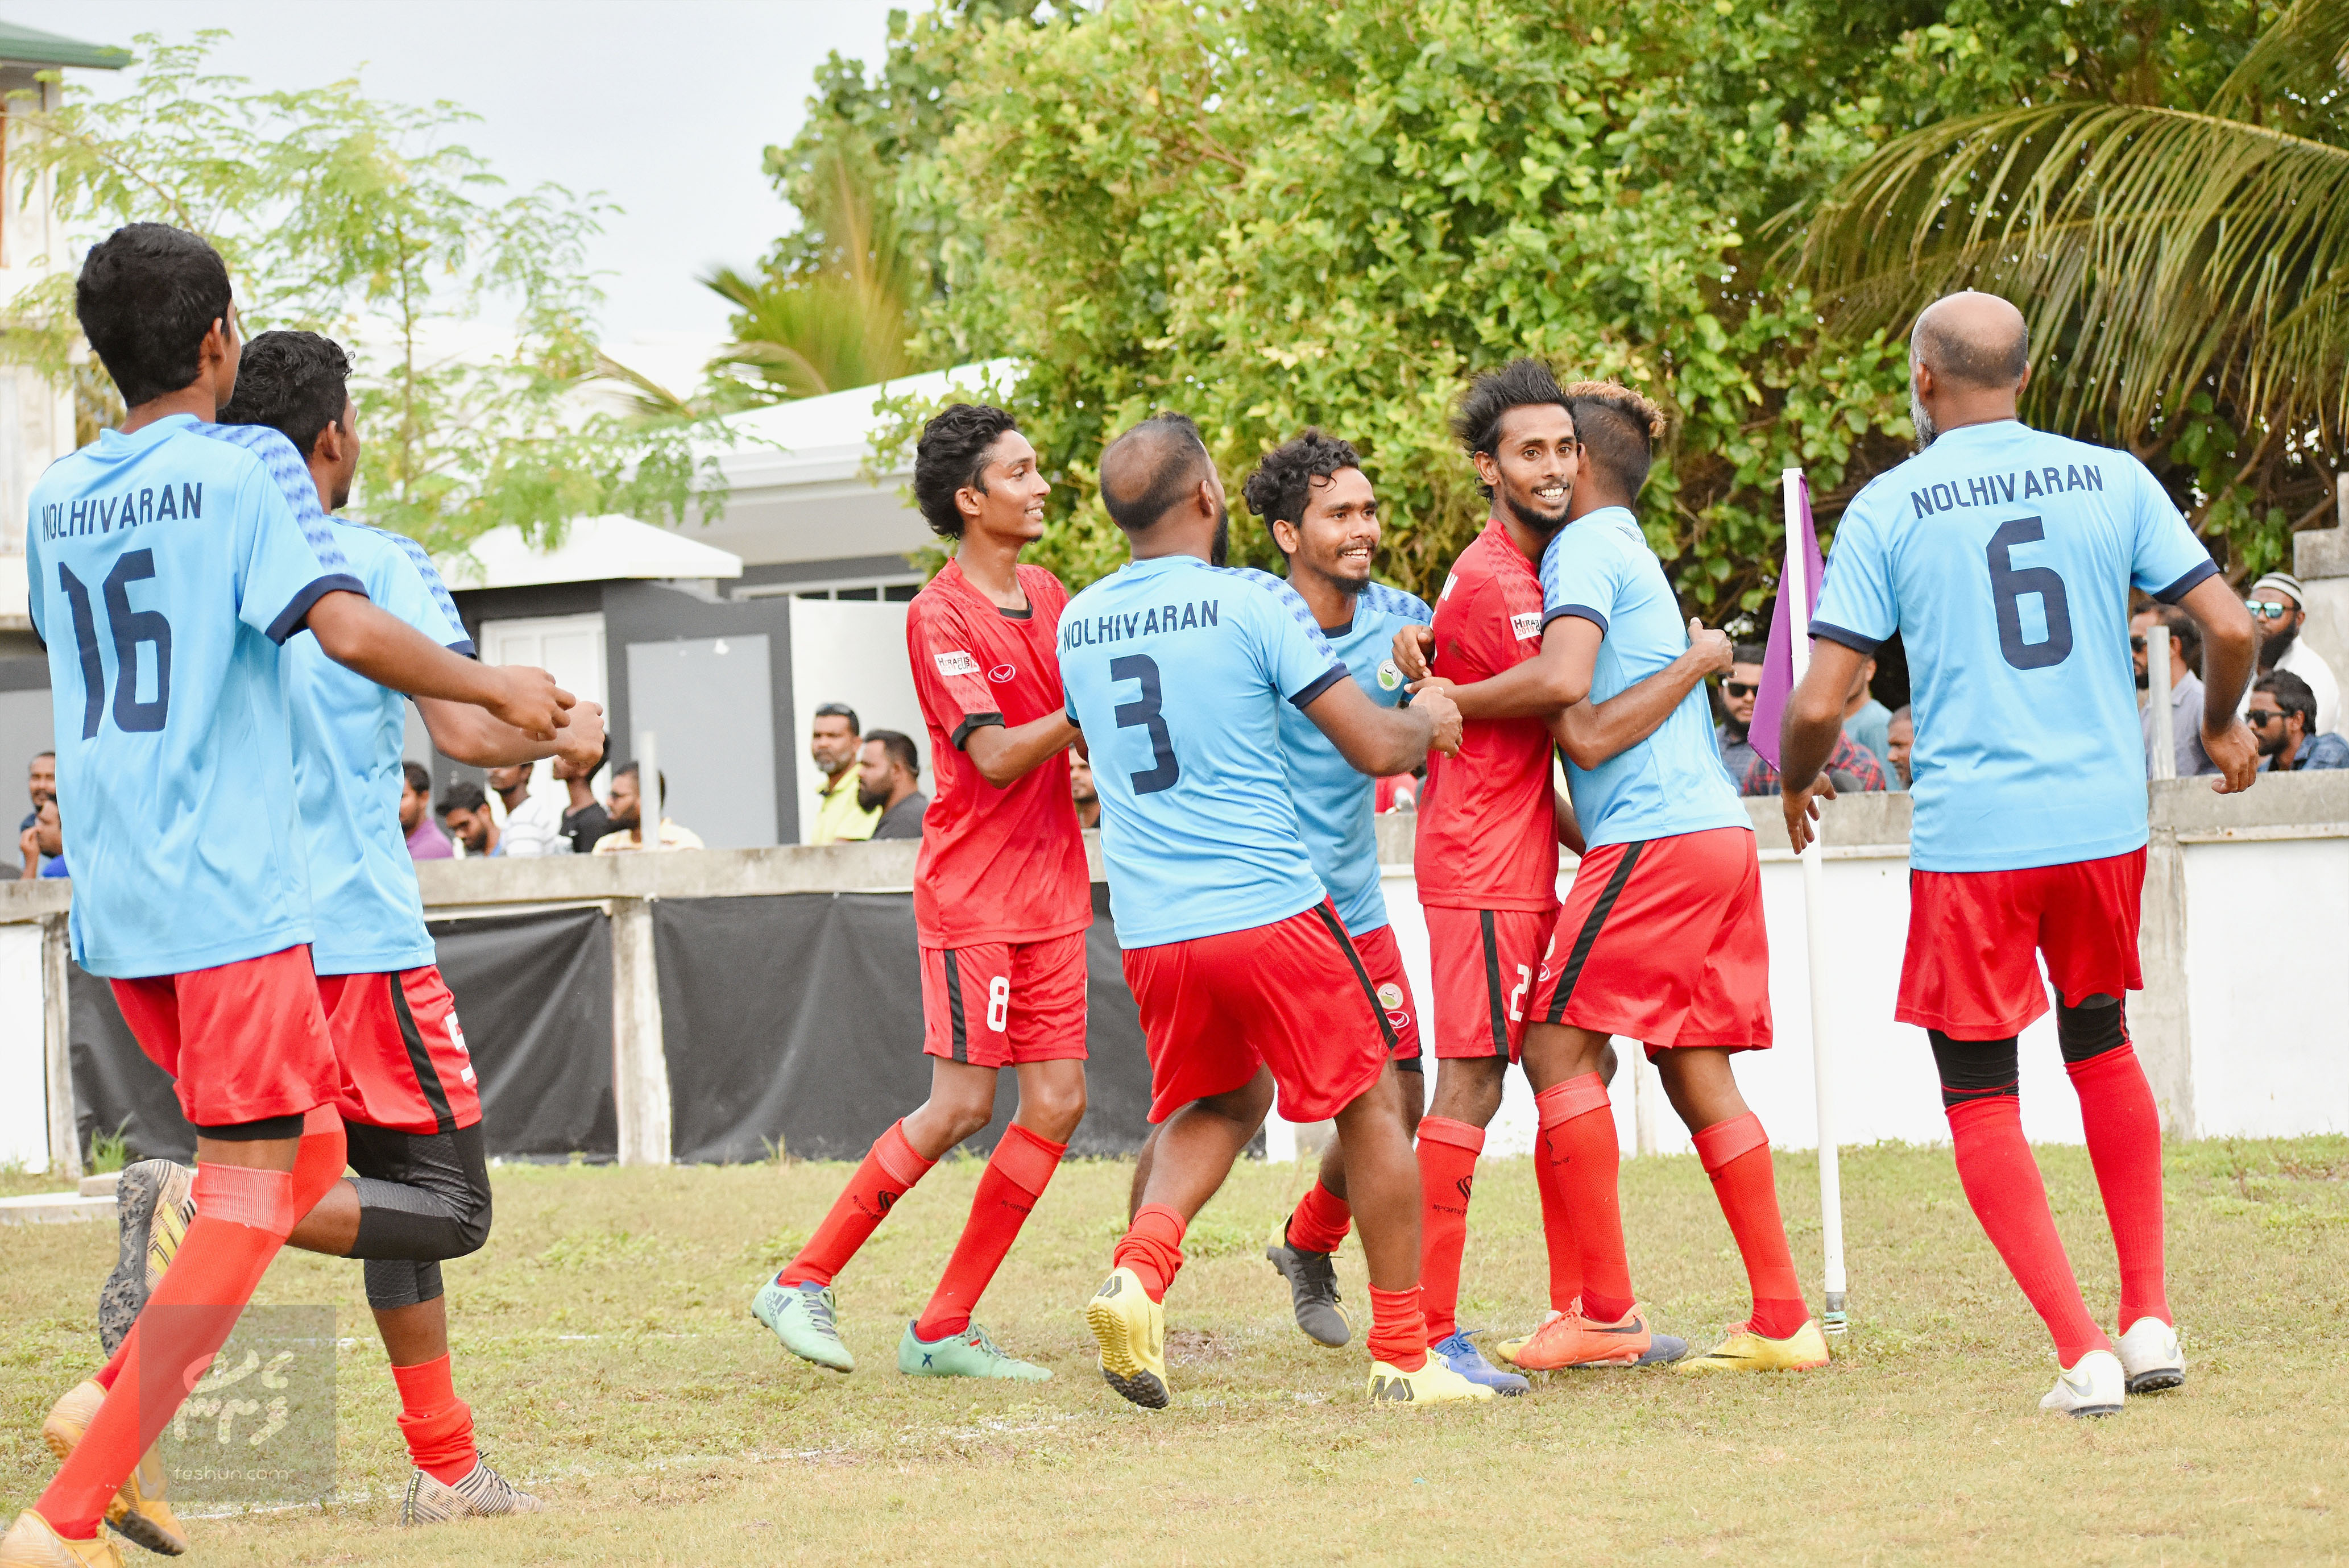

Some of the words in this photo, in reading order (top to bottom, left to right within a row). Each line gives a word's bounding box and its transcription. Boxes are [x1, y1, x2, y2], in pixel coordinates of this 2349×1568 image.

[43, 482, 202, 542] NOLHIVARAN
[1910, 464, 2104, 519] NOLHIVARAN
[1985, 516, 2074, 670] 6
[58, 547, 172, 740] 16
[1063, 599, 1219, 653] NOLHIVARAN
[1517, 625, 1535, 636] 2019
[1110, 654, 1180, 796] 3
[987, 976, 1010, 1032] 8
[1509, 964, 1532, 1022] 2
